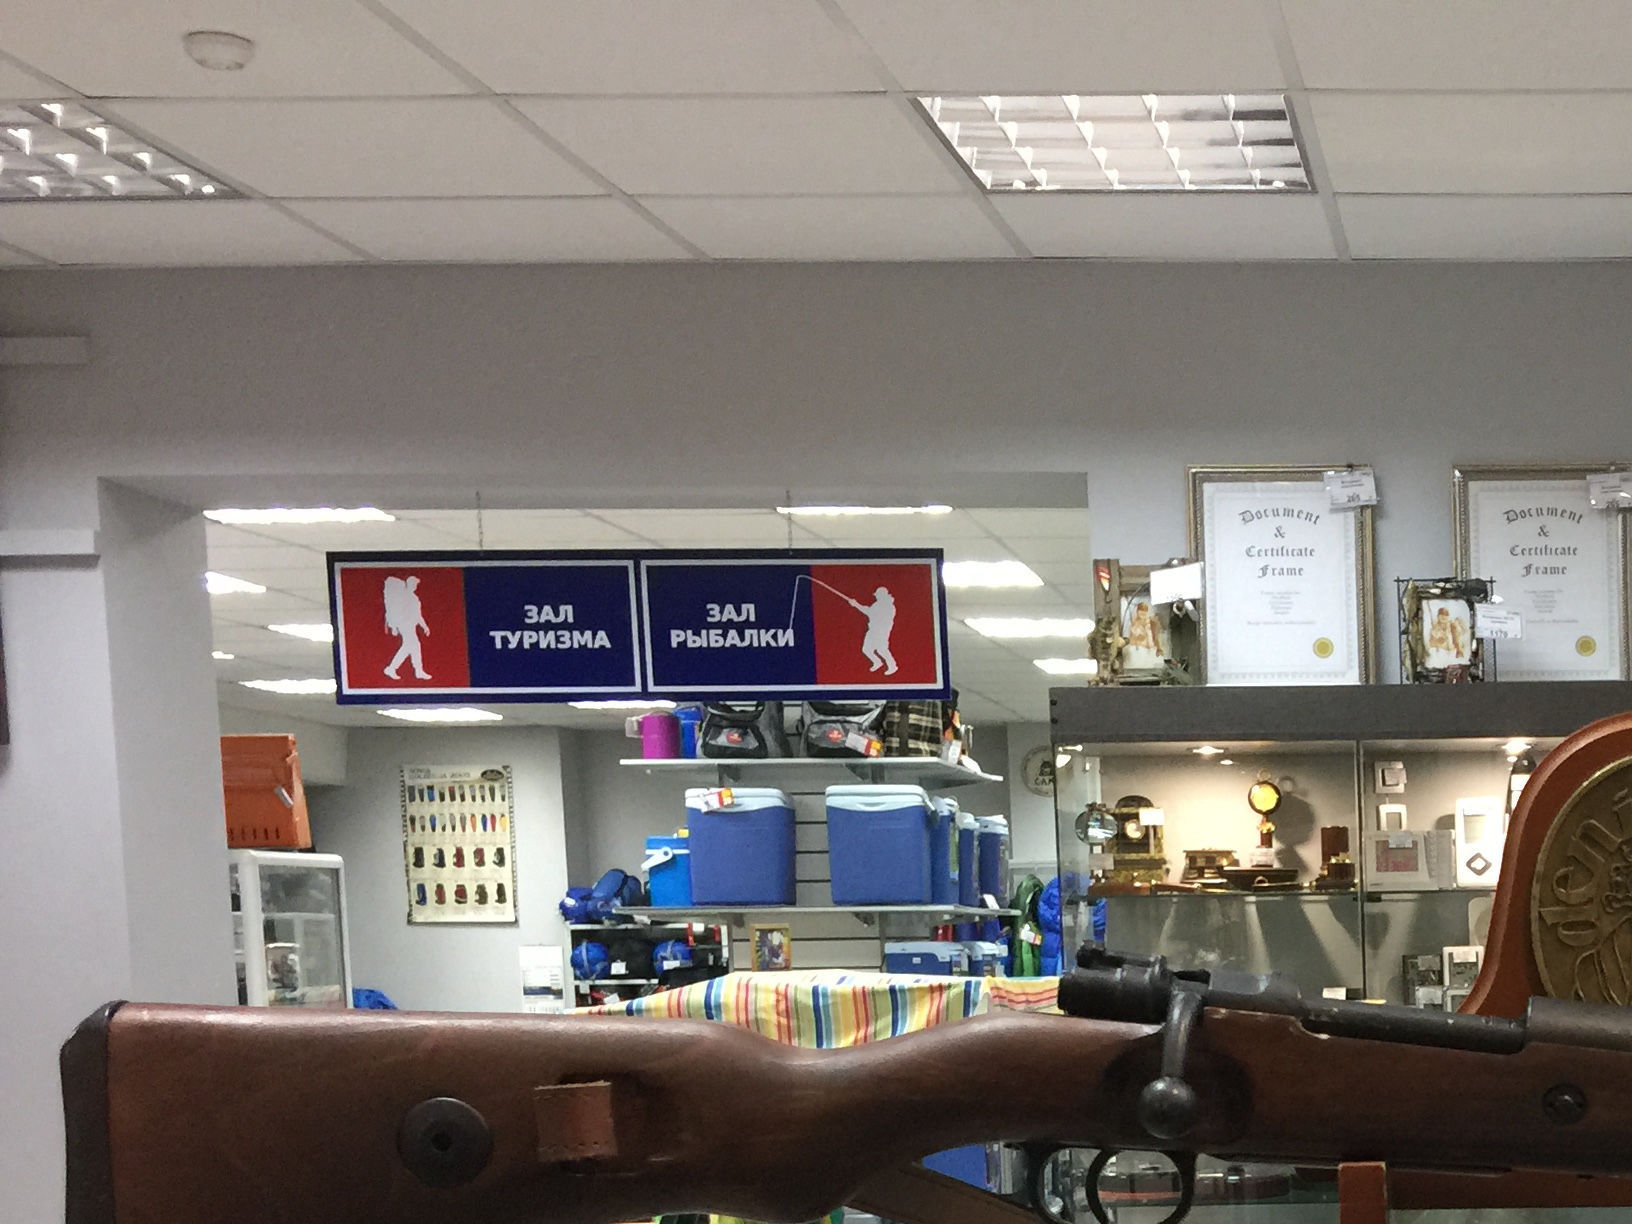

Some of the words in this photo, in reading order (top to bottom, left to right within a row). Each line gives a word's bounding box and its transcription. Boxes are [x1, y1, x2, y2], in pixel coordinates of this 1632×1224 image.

[1238, 506, 1320, 526] Document
[1502, 506, 1583, 525] Document
[1273, 525, 1286, 539] &
[1537, 524, 1550, 538] &
[1245, 545, 1316, 558] Certificate
[1509, 544, 1579, 557] Certificate
[1257, 563, 1305, 579] Frame
[1520, 562, 1568, 578] Frame
[524, 604, 575, 624] ЗАЛ
[706, 603, 756, 623] ЗАЛ
[489, 629, 612, 650] ТУРИЗМА
[670, 628, 795, 649] РЫБАЛКИ
